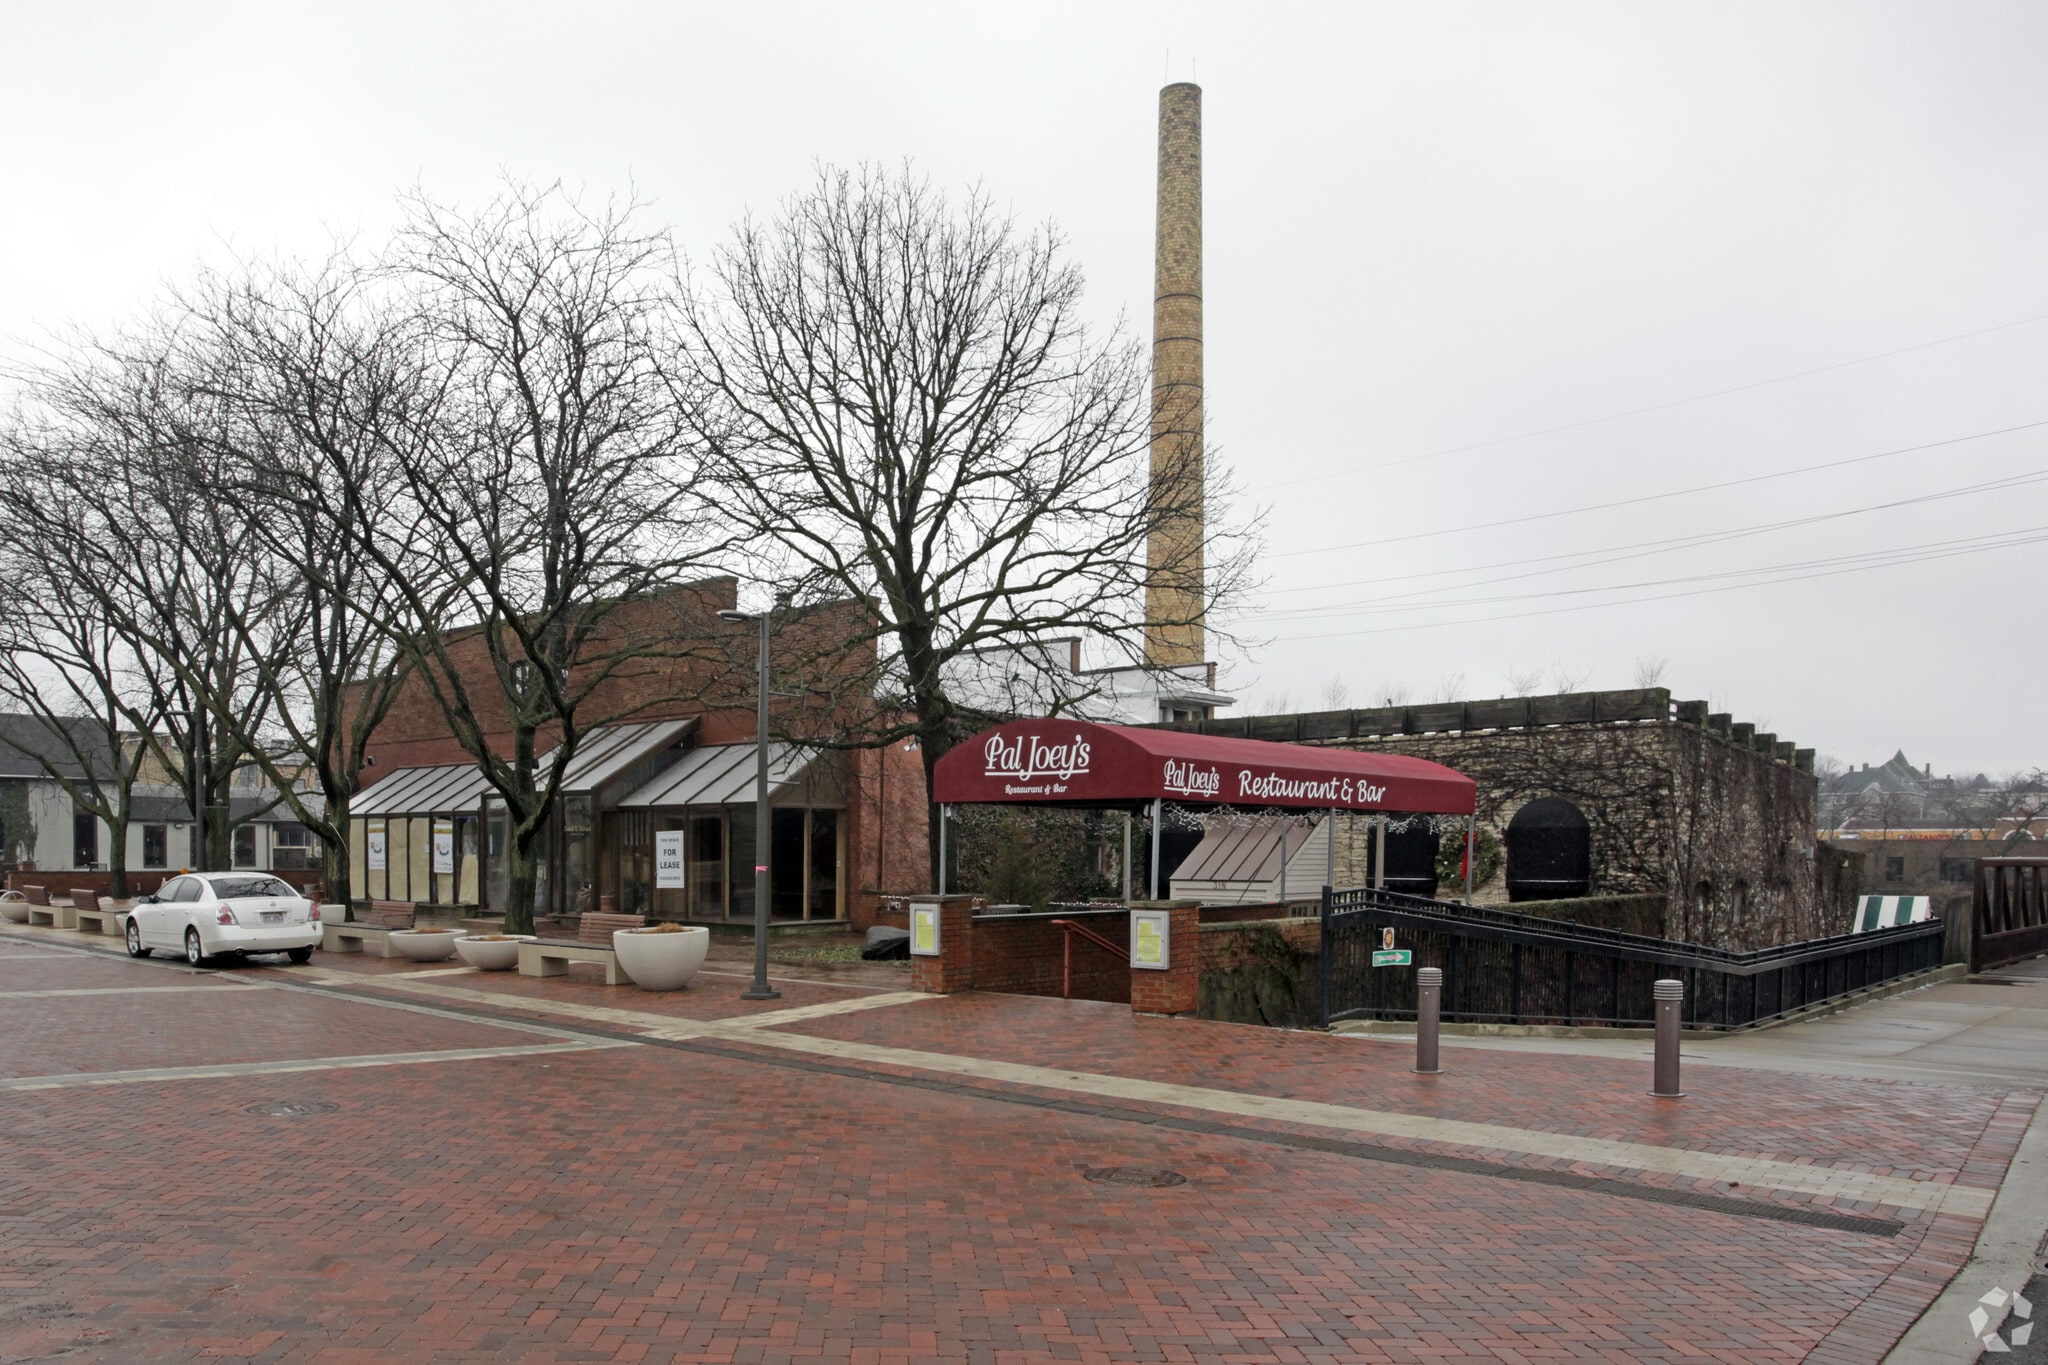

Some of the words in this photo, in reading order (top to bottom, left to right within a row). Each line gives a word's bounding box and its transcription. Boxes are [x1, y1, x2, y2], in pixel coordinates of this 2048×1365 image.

[985, 732, 1022, 770] Pal
[1019, 734, 1091, 781] Joey's
[1005, 784, 1043, 795] Restaurant
[1044, 784, 1052, 795] &
[1053, 783, 1067, 793] Bar
[1164, 758, 1185, 786] Pal
[1183, 763, 1220, 797] Joey's
[1239, 770, 1341, 800] Restaurant
[1341, 779, 1354, 804] &
[1357, 779, 1387, 803] Bar
[664, 849, 677, 857] FOR
[660, 861, 680, 869] LEASE
